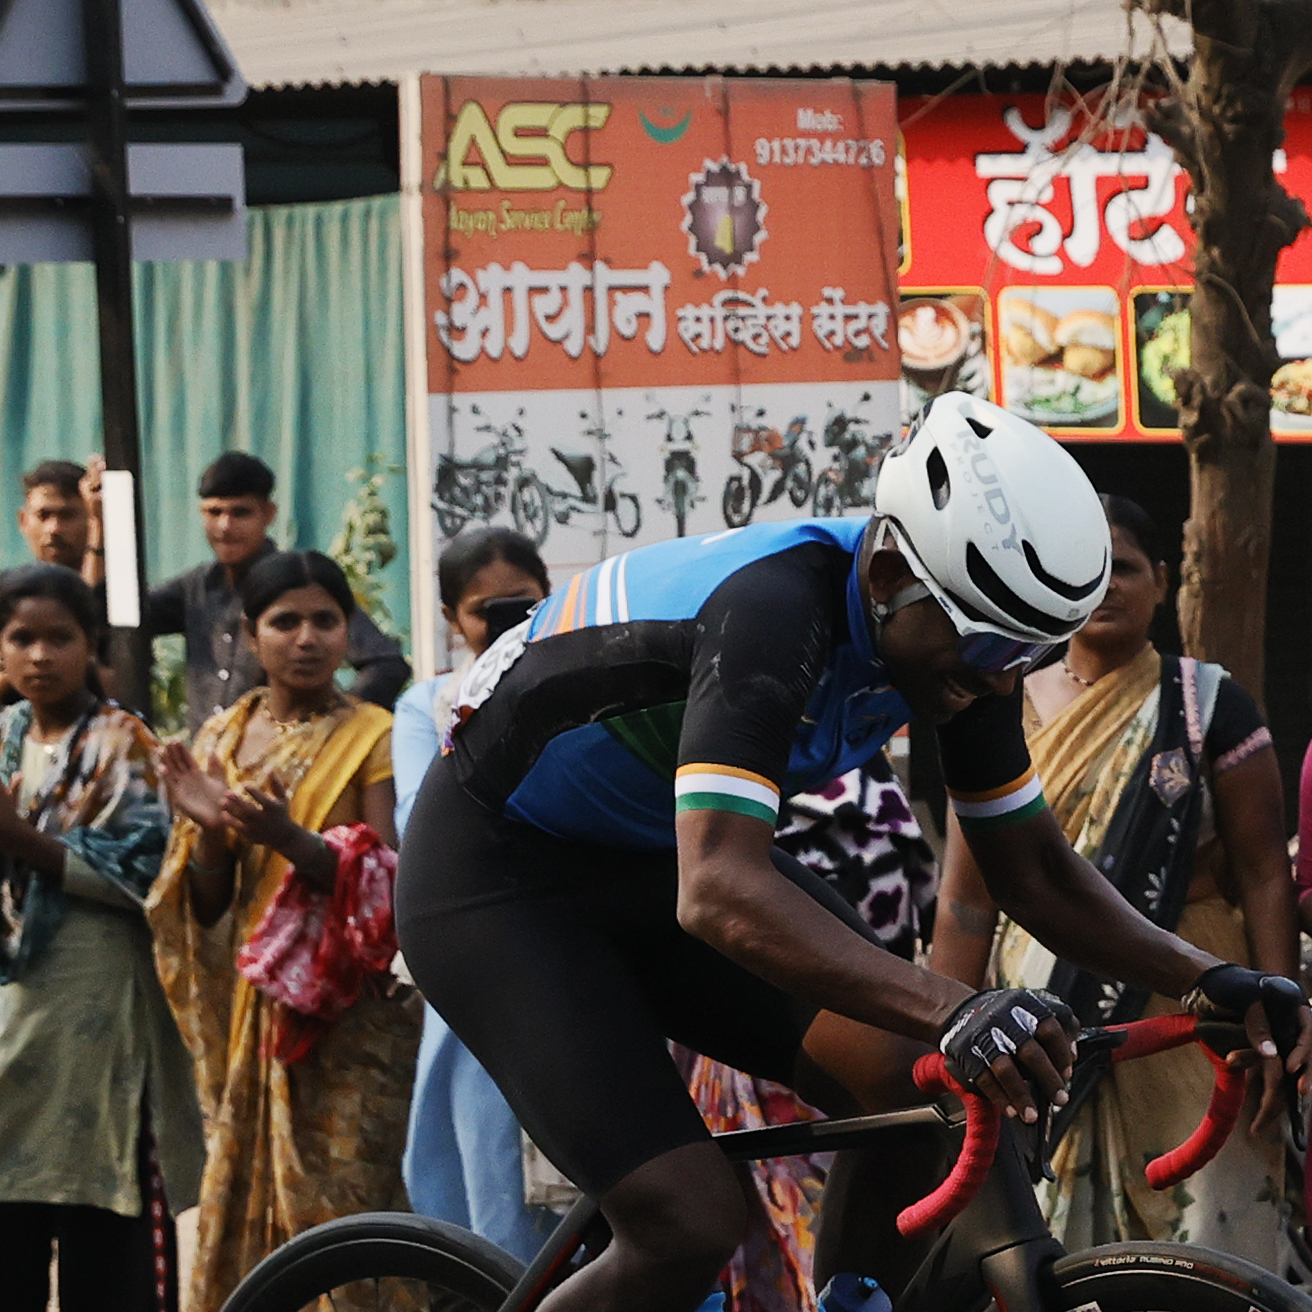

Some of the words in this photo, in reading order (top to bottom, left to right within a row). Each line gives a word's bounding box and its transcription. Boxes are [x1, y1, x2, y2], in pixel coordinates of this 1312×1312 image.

[434, 100, 613, 189] ASC
[754, 137, 885, 166] 9137344726
[435, 261, 671, 361] आयान
[676, 288, 803, 357] सर्व्हिस
[811, 287, 891, 353] सेंटर
[957, 430, 1024, 556] RUDY
